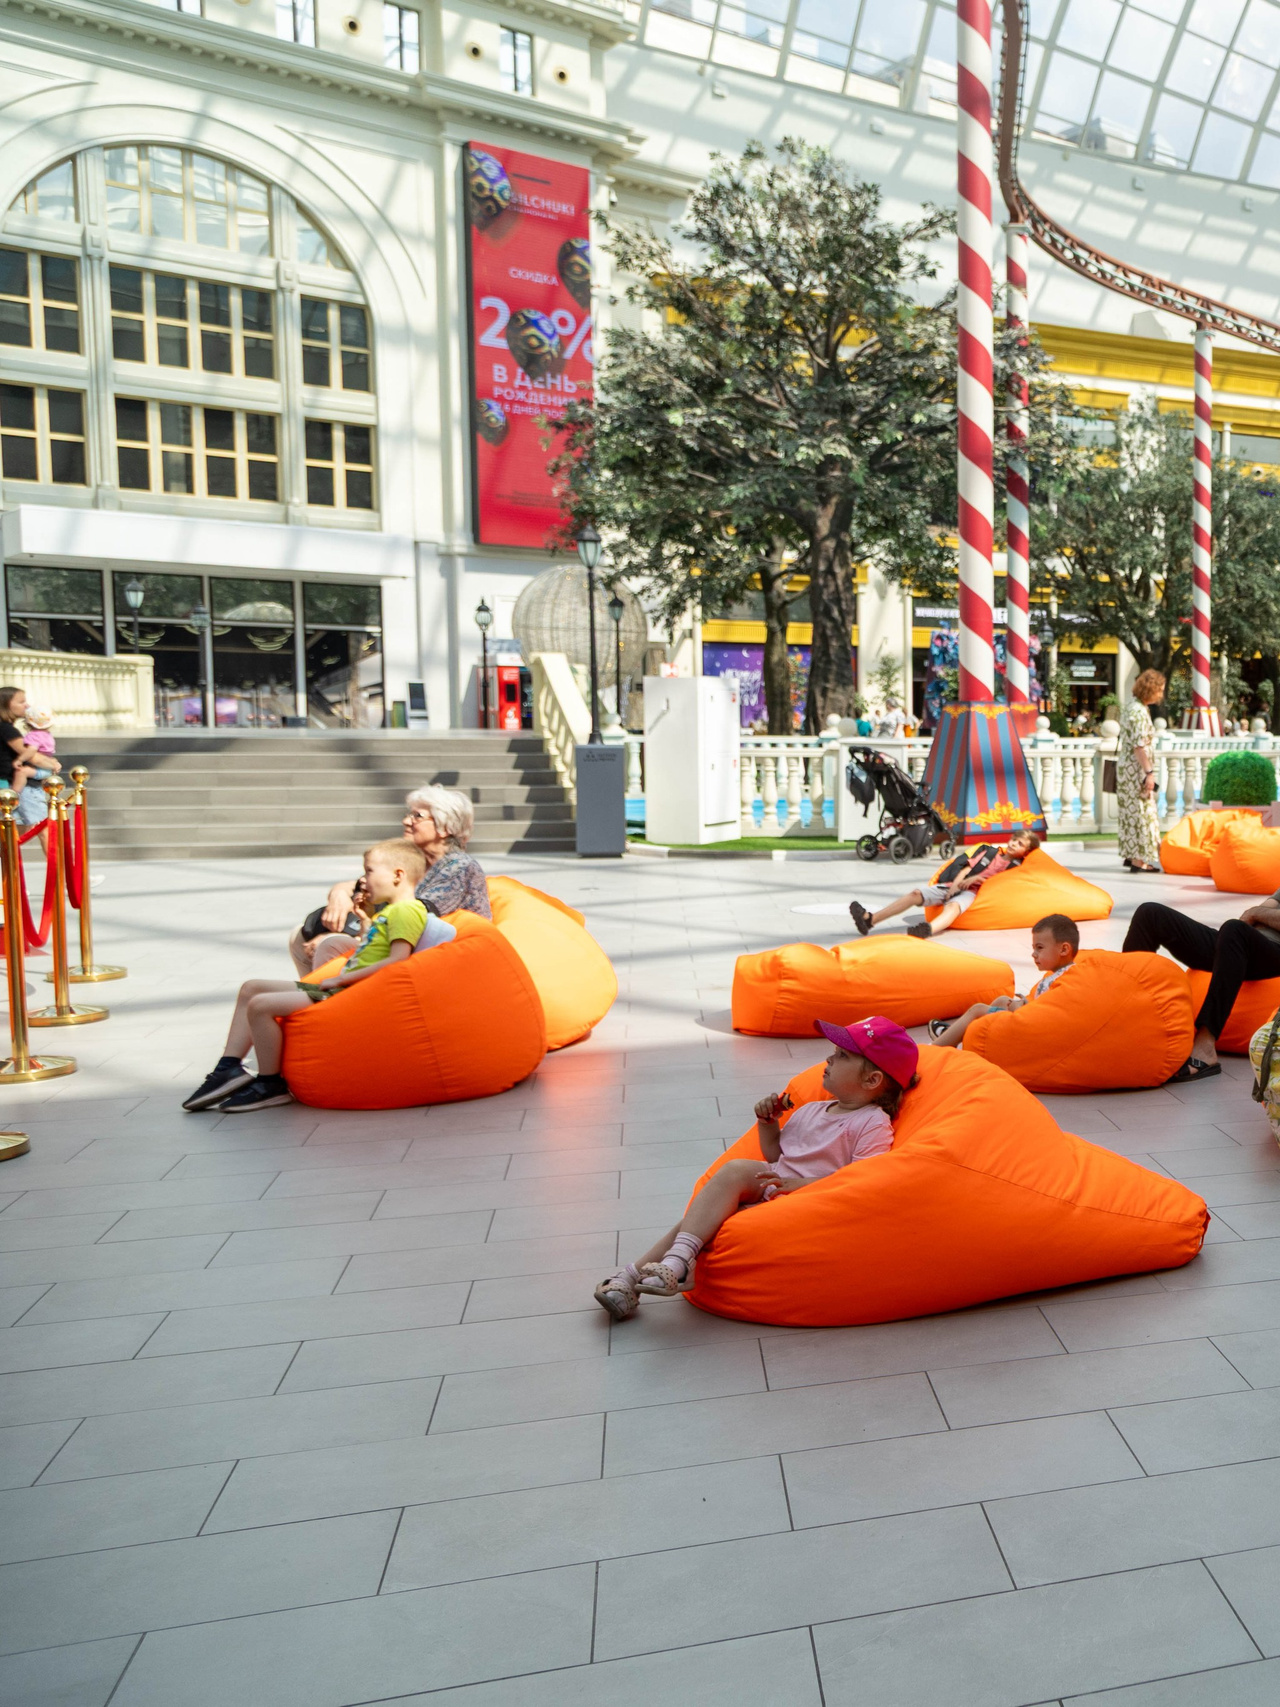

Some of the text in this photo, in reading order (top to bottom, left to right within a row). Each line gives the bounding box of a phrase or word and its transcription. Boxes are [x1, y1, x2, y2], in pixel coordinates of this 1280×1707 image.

[508, 266, 559, 287] СКИДКА
[479, 295, 593, 364] 2%
[492, 363, 509, 383] В
